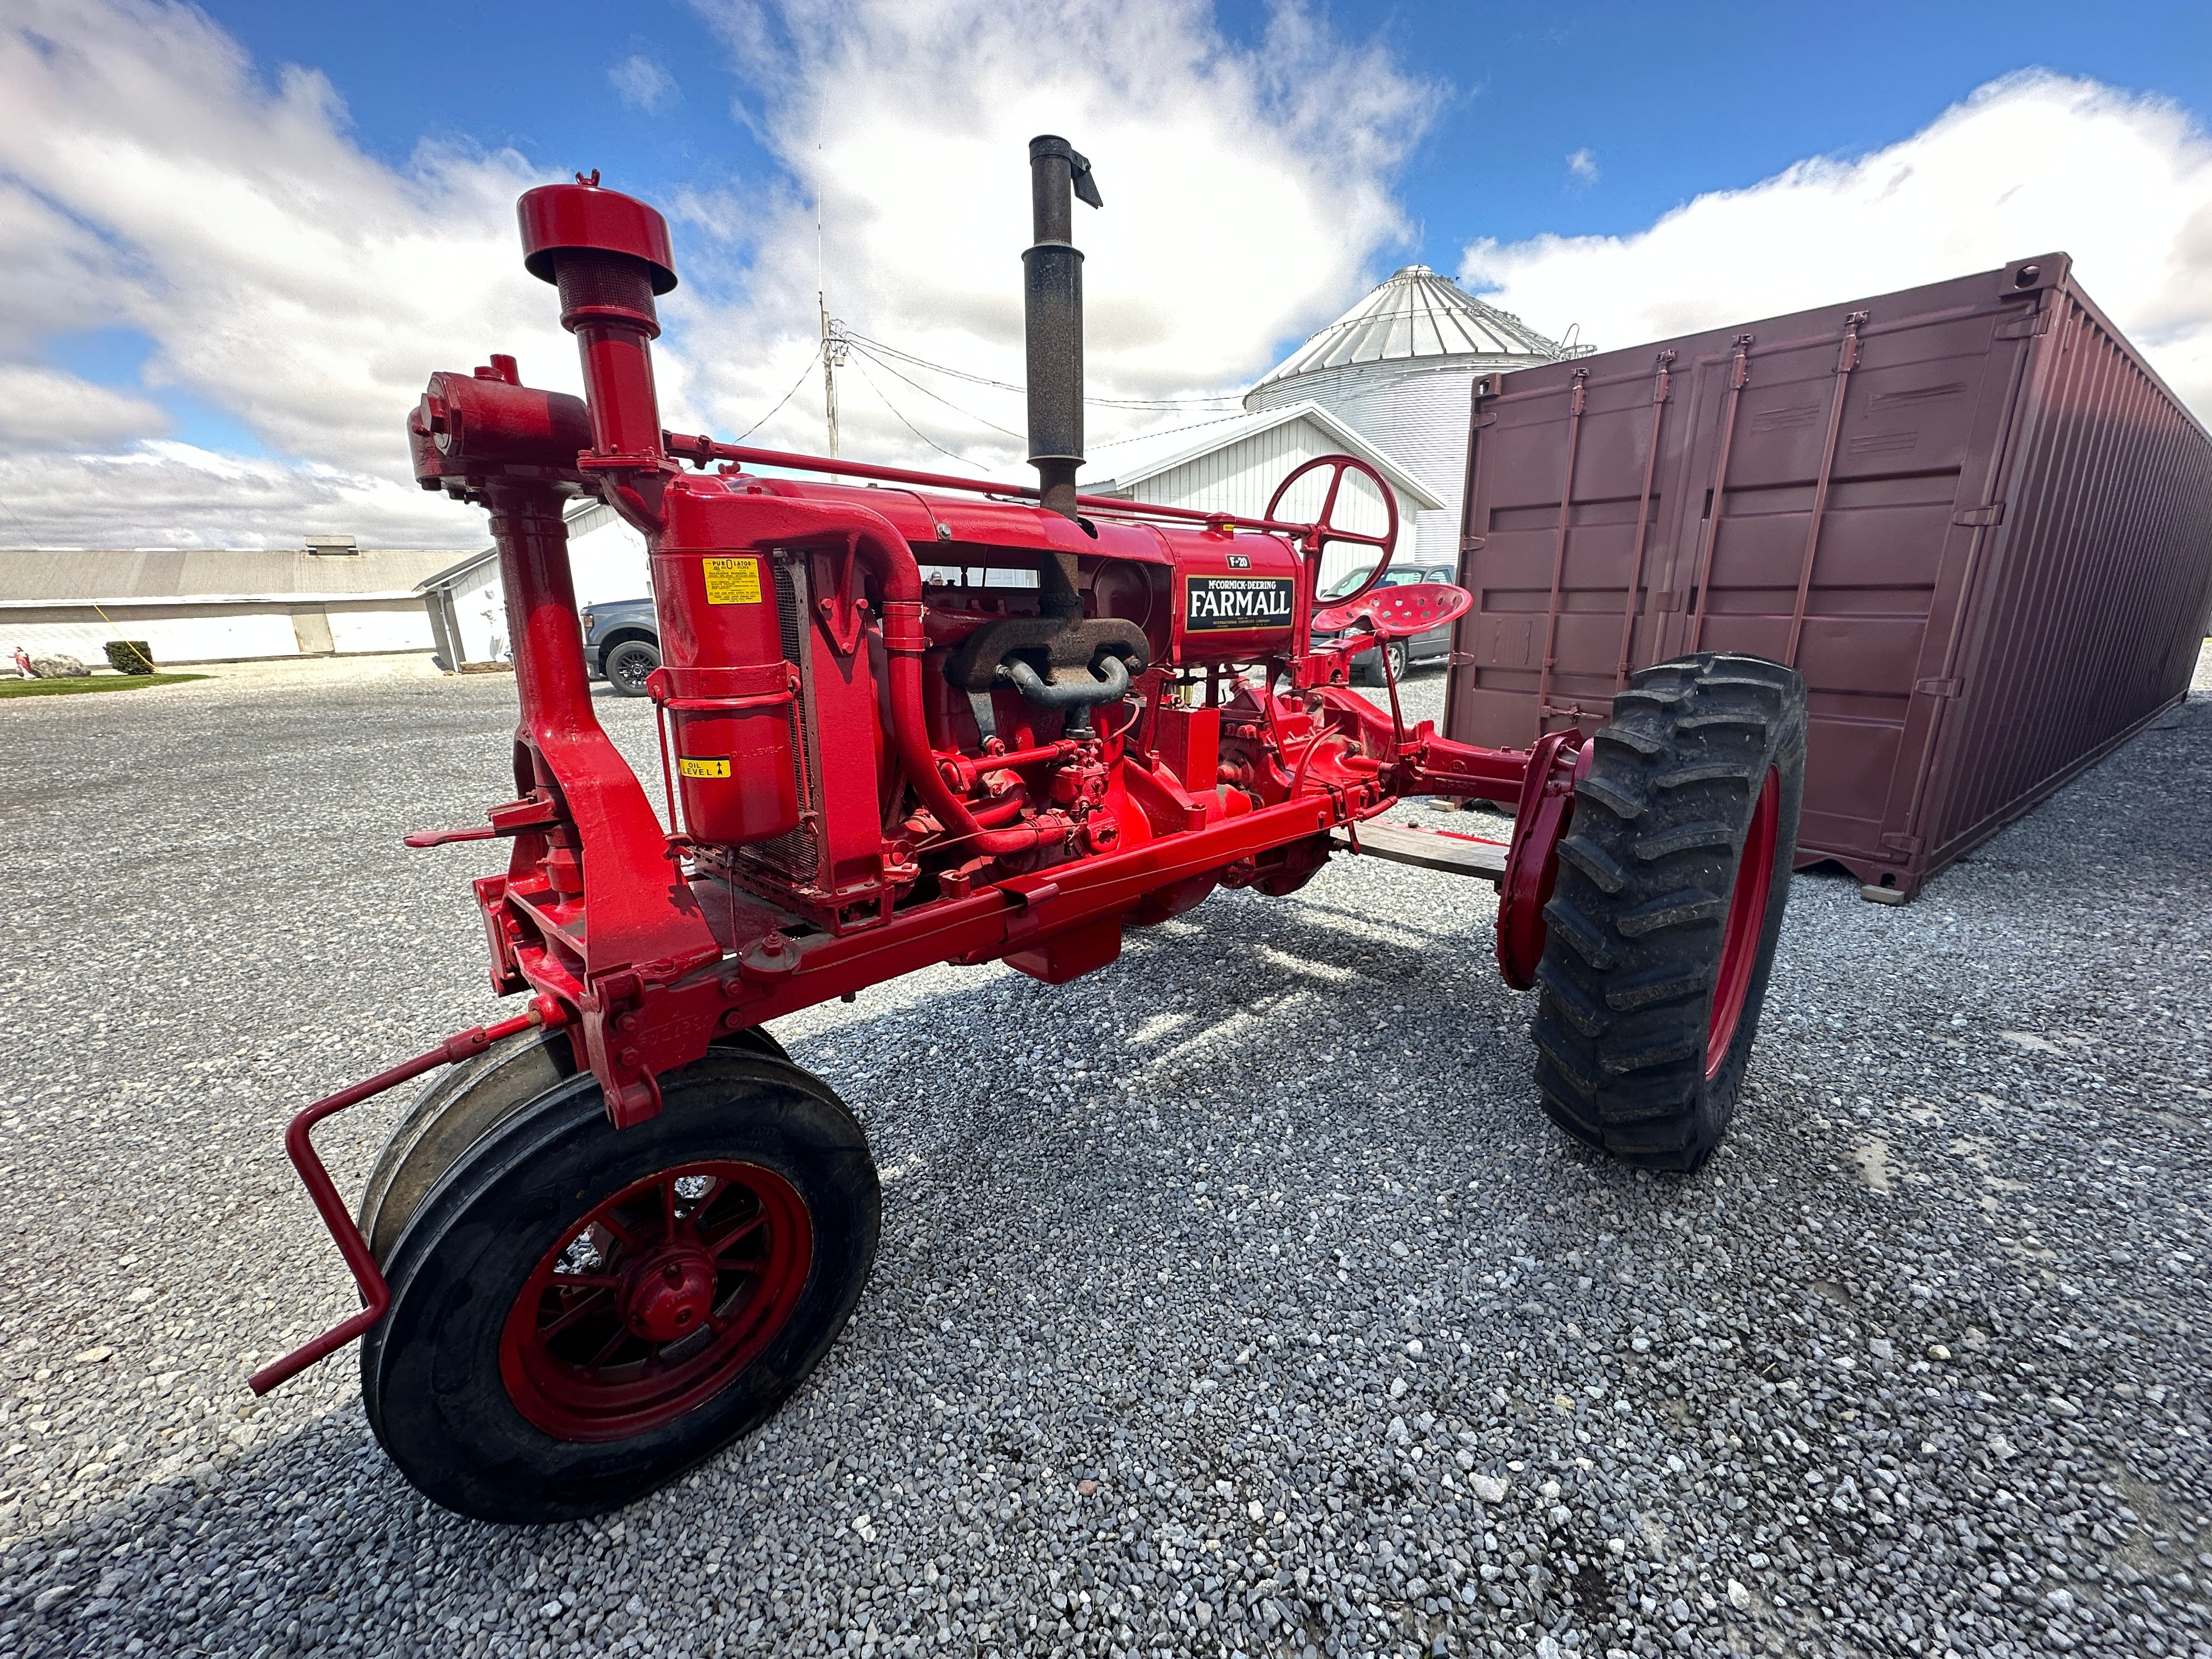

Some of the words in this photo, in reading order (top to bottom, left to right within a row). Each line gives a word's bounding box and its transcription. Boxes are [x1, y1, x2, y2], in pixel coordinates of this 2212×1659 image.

[1229, 556, 1248, 567] F-20
[1190, 591, 1290, 617] FARMALL
[683, 768, 713, 776] LEVEL
